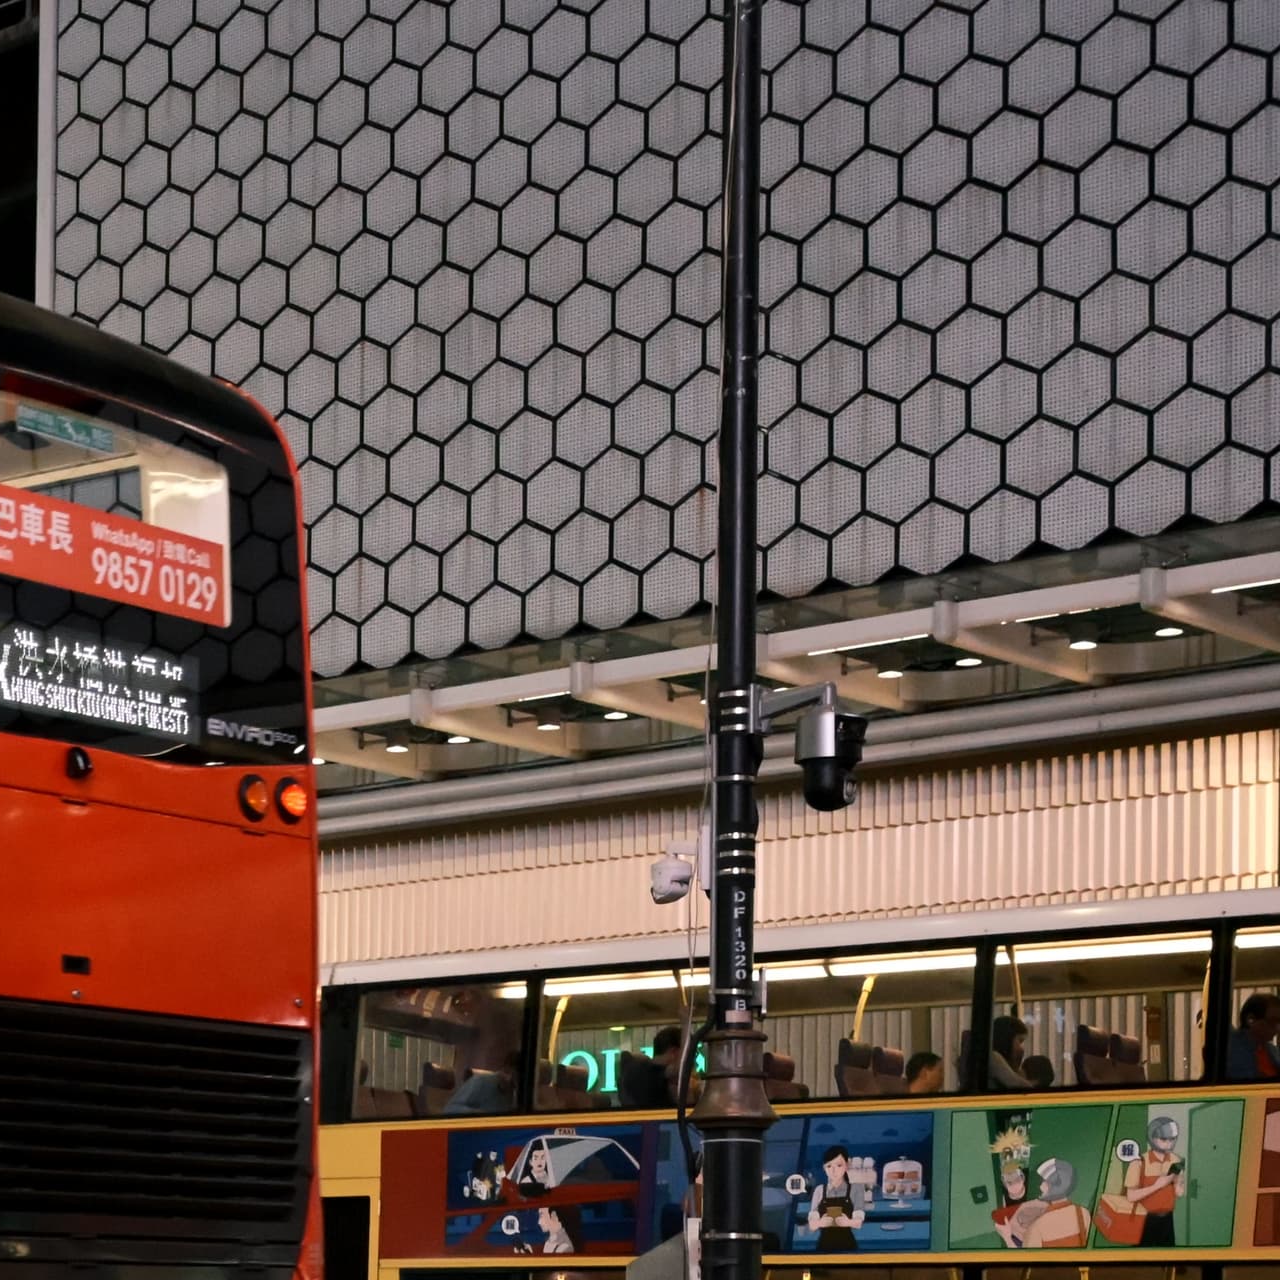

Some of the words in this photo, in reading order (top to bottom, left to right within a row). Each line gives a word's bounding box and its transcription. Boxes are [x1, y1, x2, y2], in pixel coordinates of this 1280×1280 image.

[91, 521, 155, 556] WhatsApp
[91, 547, 153, 596] 9857
[159, 565, 217, 612] 0129
